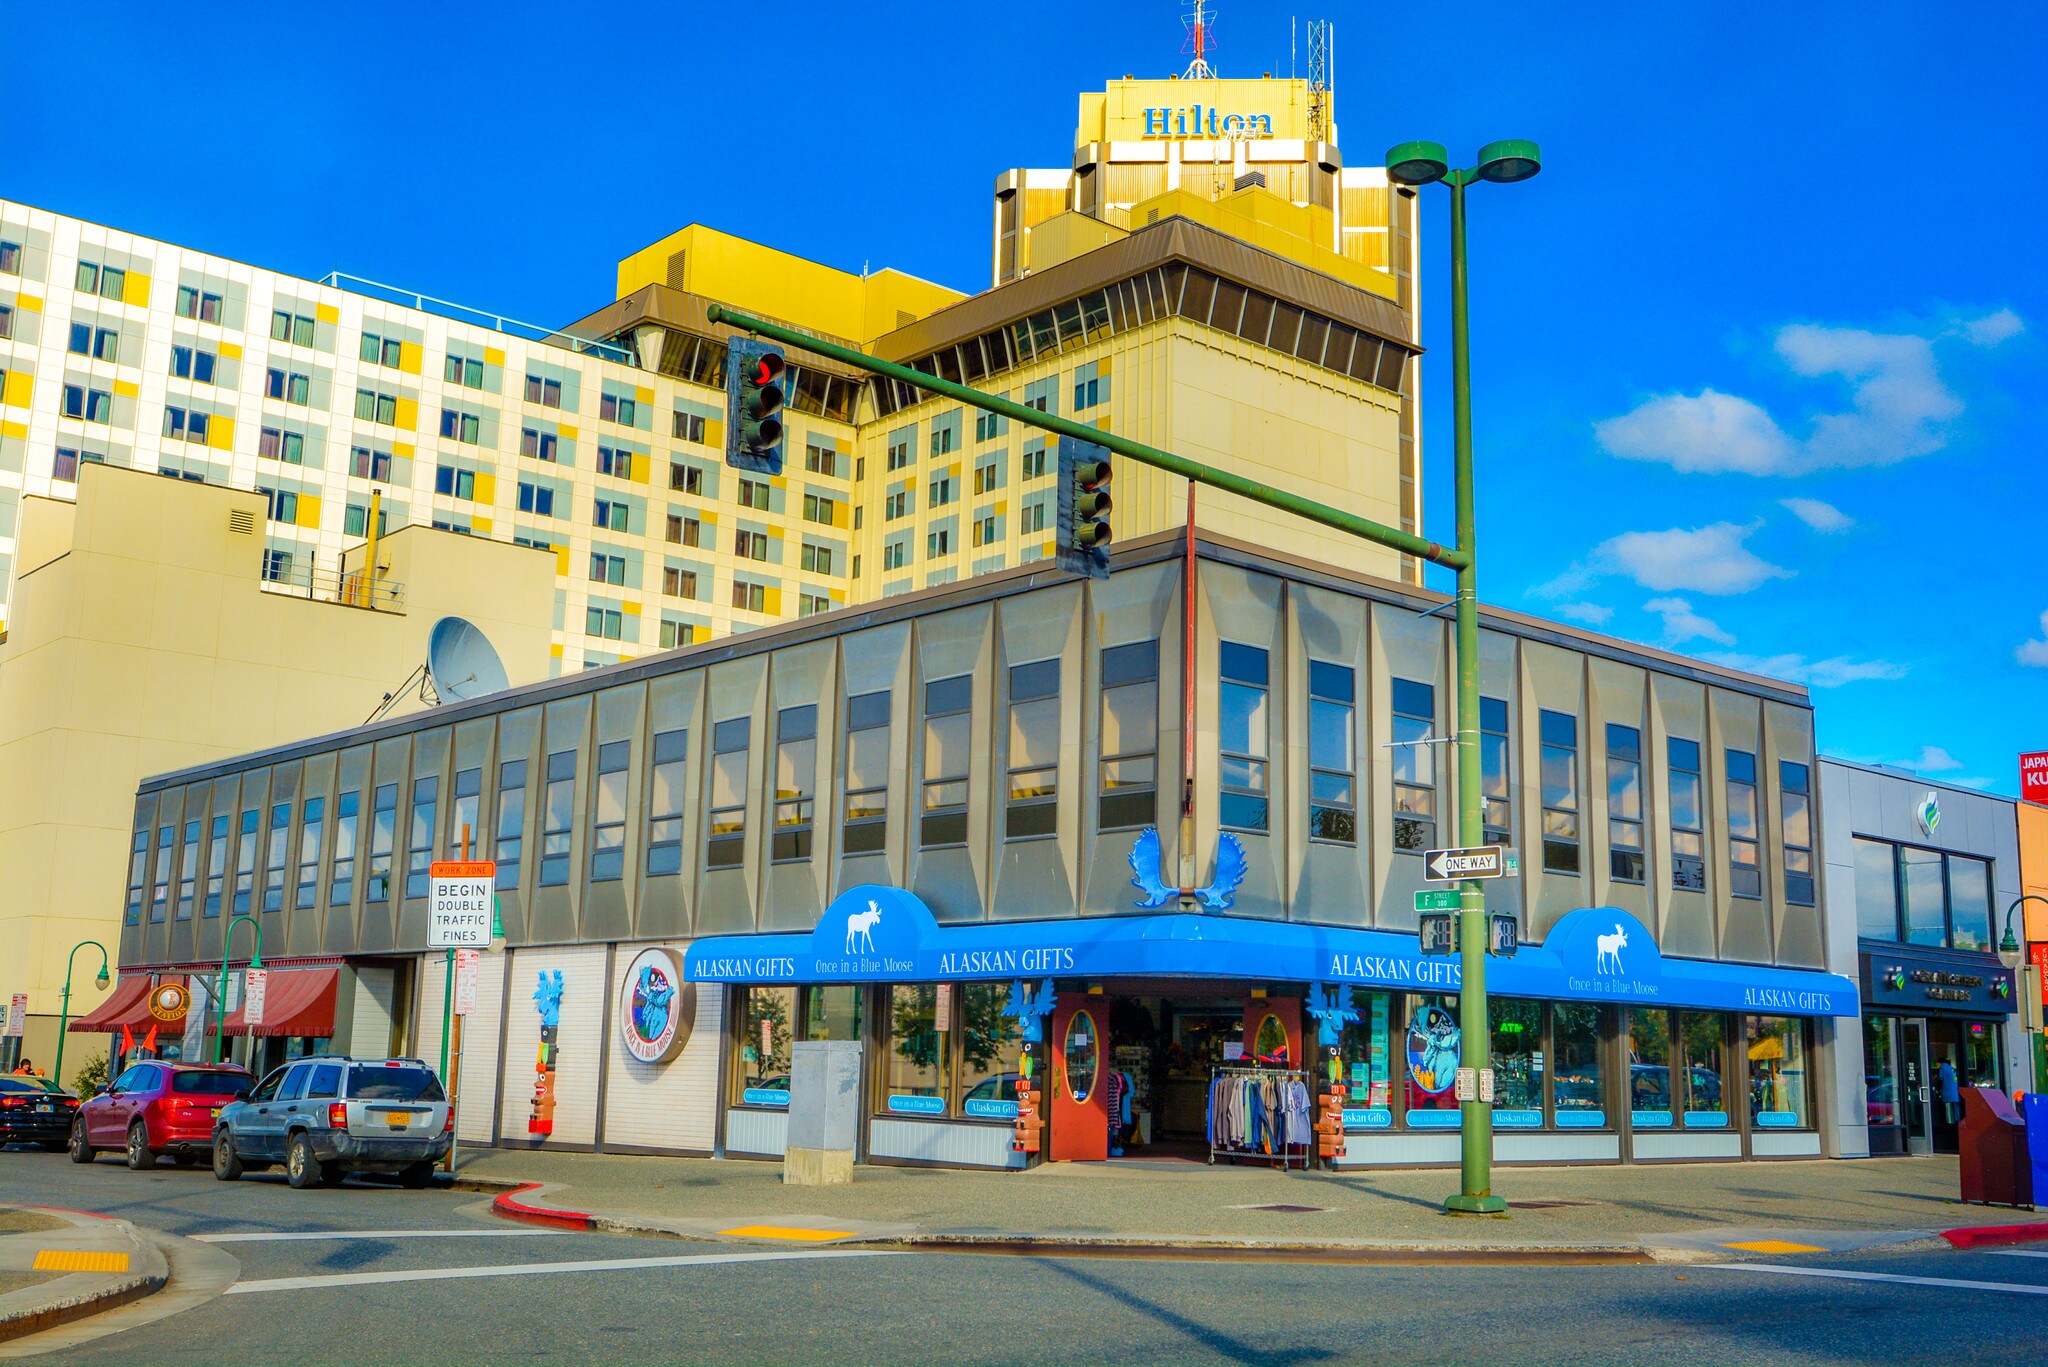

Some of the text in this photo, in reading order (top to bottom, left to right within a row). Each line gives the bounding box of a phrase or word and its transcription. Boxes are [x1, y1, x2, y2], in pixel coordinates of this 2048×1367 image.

[1143, 104, 1273, 135] Hilton
[2022, 756, 2048, 769] JAPA
[1446, 856, 1492, 870] ONE WAY
[438, 866, 487, 875] WORK ZONE
[438, 884, 486, 897] BEGIN
[438, 900, 484, 911] DOUBLE
[1425, 894, 1430, 906] F
[437, 915, 485, 926] TRAFFIC
[443, 930, 477, 941] FINES
[694, 957, 794, 977] ALASKAN GIFTS
[815, 957, 914, 973] Once in a Blue Moose
[939, 947, 1074, 974] ALASKAN GIFTS
[1330, 954, 1461, 985] ALASKAN GIFTS
[1569, 976, 1659, 995] Once in a Blue Moose
[1744, 987, 1831, 1011] ALASKAN GIFTS
[152, 1005, 187, 1019] STATION
[971, 1102, 1000, 1113] Alaskan
[1342, 1112, 1386, 1123] laskan Gifts
[1495, 1113, 1538, 1122] Alaskan Gifts
[1655, 1113, 1669, 1123] Gifts
